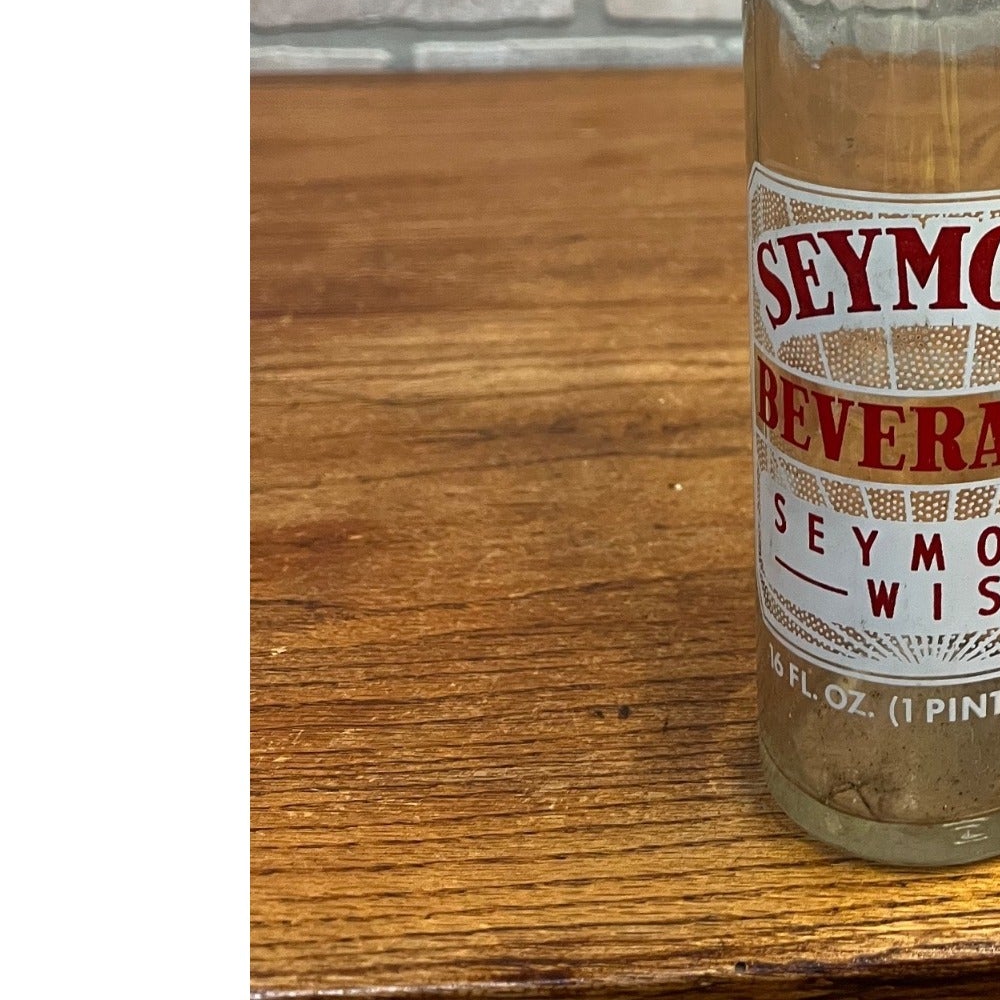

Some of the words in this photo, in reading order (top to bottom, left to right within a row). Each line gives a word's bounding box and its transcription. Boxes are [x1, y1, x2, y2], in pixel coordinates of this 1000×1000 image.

[769, 642, 784, 677] 16
[789, 662, 818, 701] FL.
[824, 683, 875, 718] OZ.
[888, 696, 912, 727] (1
